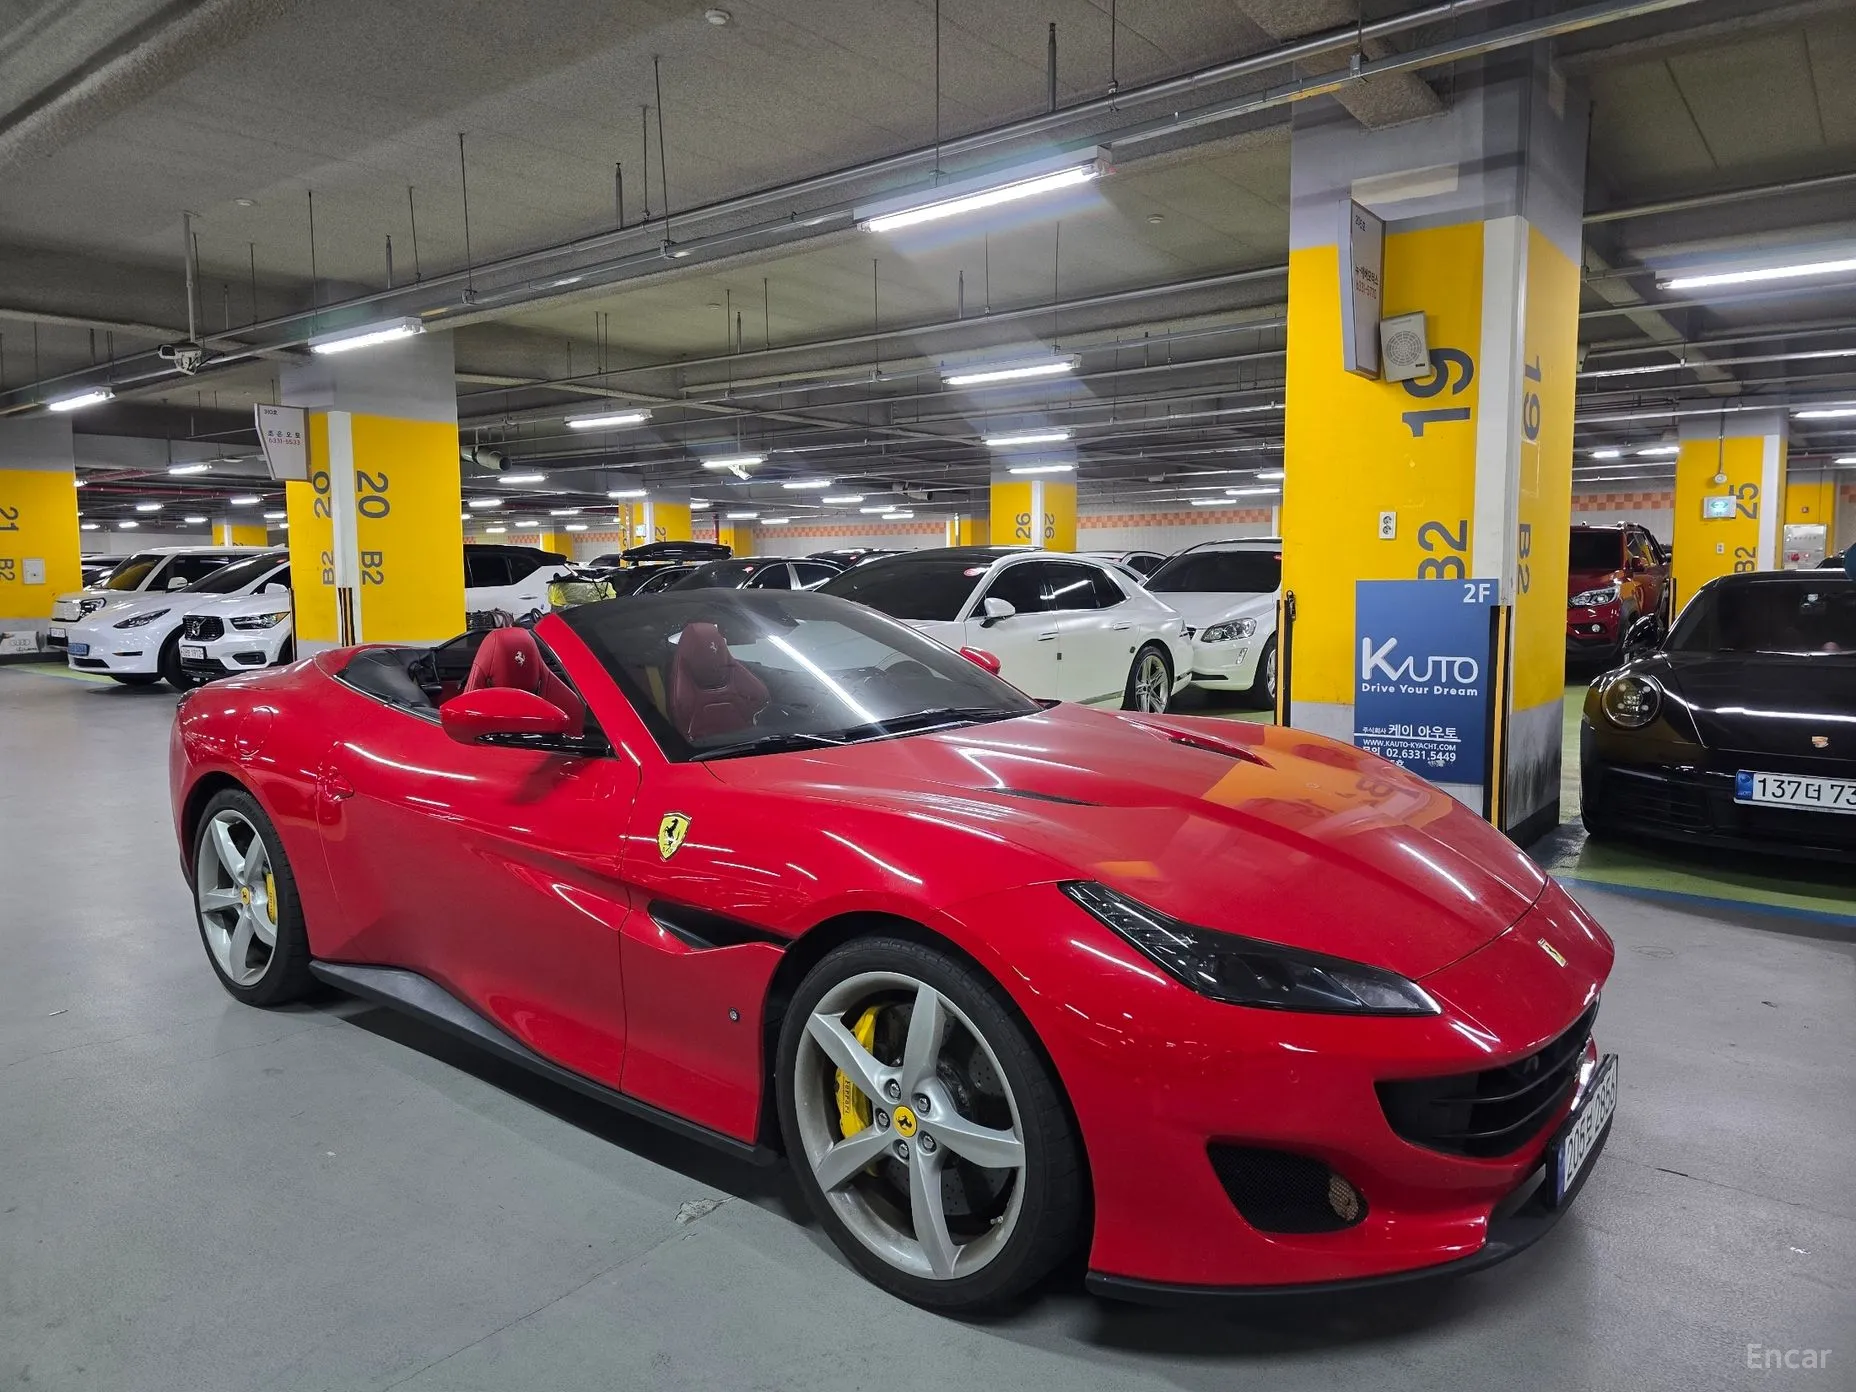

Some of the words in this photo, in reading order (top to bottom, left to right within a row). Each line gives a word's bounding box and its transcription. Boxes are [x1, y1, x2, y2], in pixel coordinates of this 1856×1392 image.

[1402, 348, 1474, 437] 19
[1524, 355, 1541, 441] 19
[313, 471, 332, 518] 20
[357, 471, 390, 519] 20
[1729, 483, 1759, 519] 25
[1016, 512, 1031, 539] 26
[1044, 513, 1055, 539] 26
[1418, 520, 1468, 579] B2
[321, 551, 334, 585] B2
[361, 551, 385, 585] B2
[1463, 583, 1491, 603] 2F
[1361, 683, 1396, 694] Drive
[1400, 684, 1429, 695] Your
[1434, 685, 1478, 697] Dream
[1362, 738, 1457, 752] WWW.KAUTO-KYACHT.COM
[1388, 724, 1413, 738] 케이
[1418, 725, 1458, 739] 아우토
[1386, 748, 1457, 762] 02.6331.5449
[1758, 777, 1822, 802] 137더
